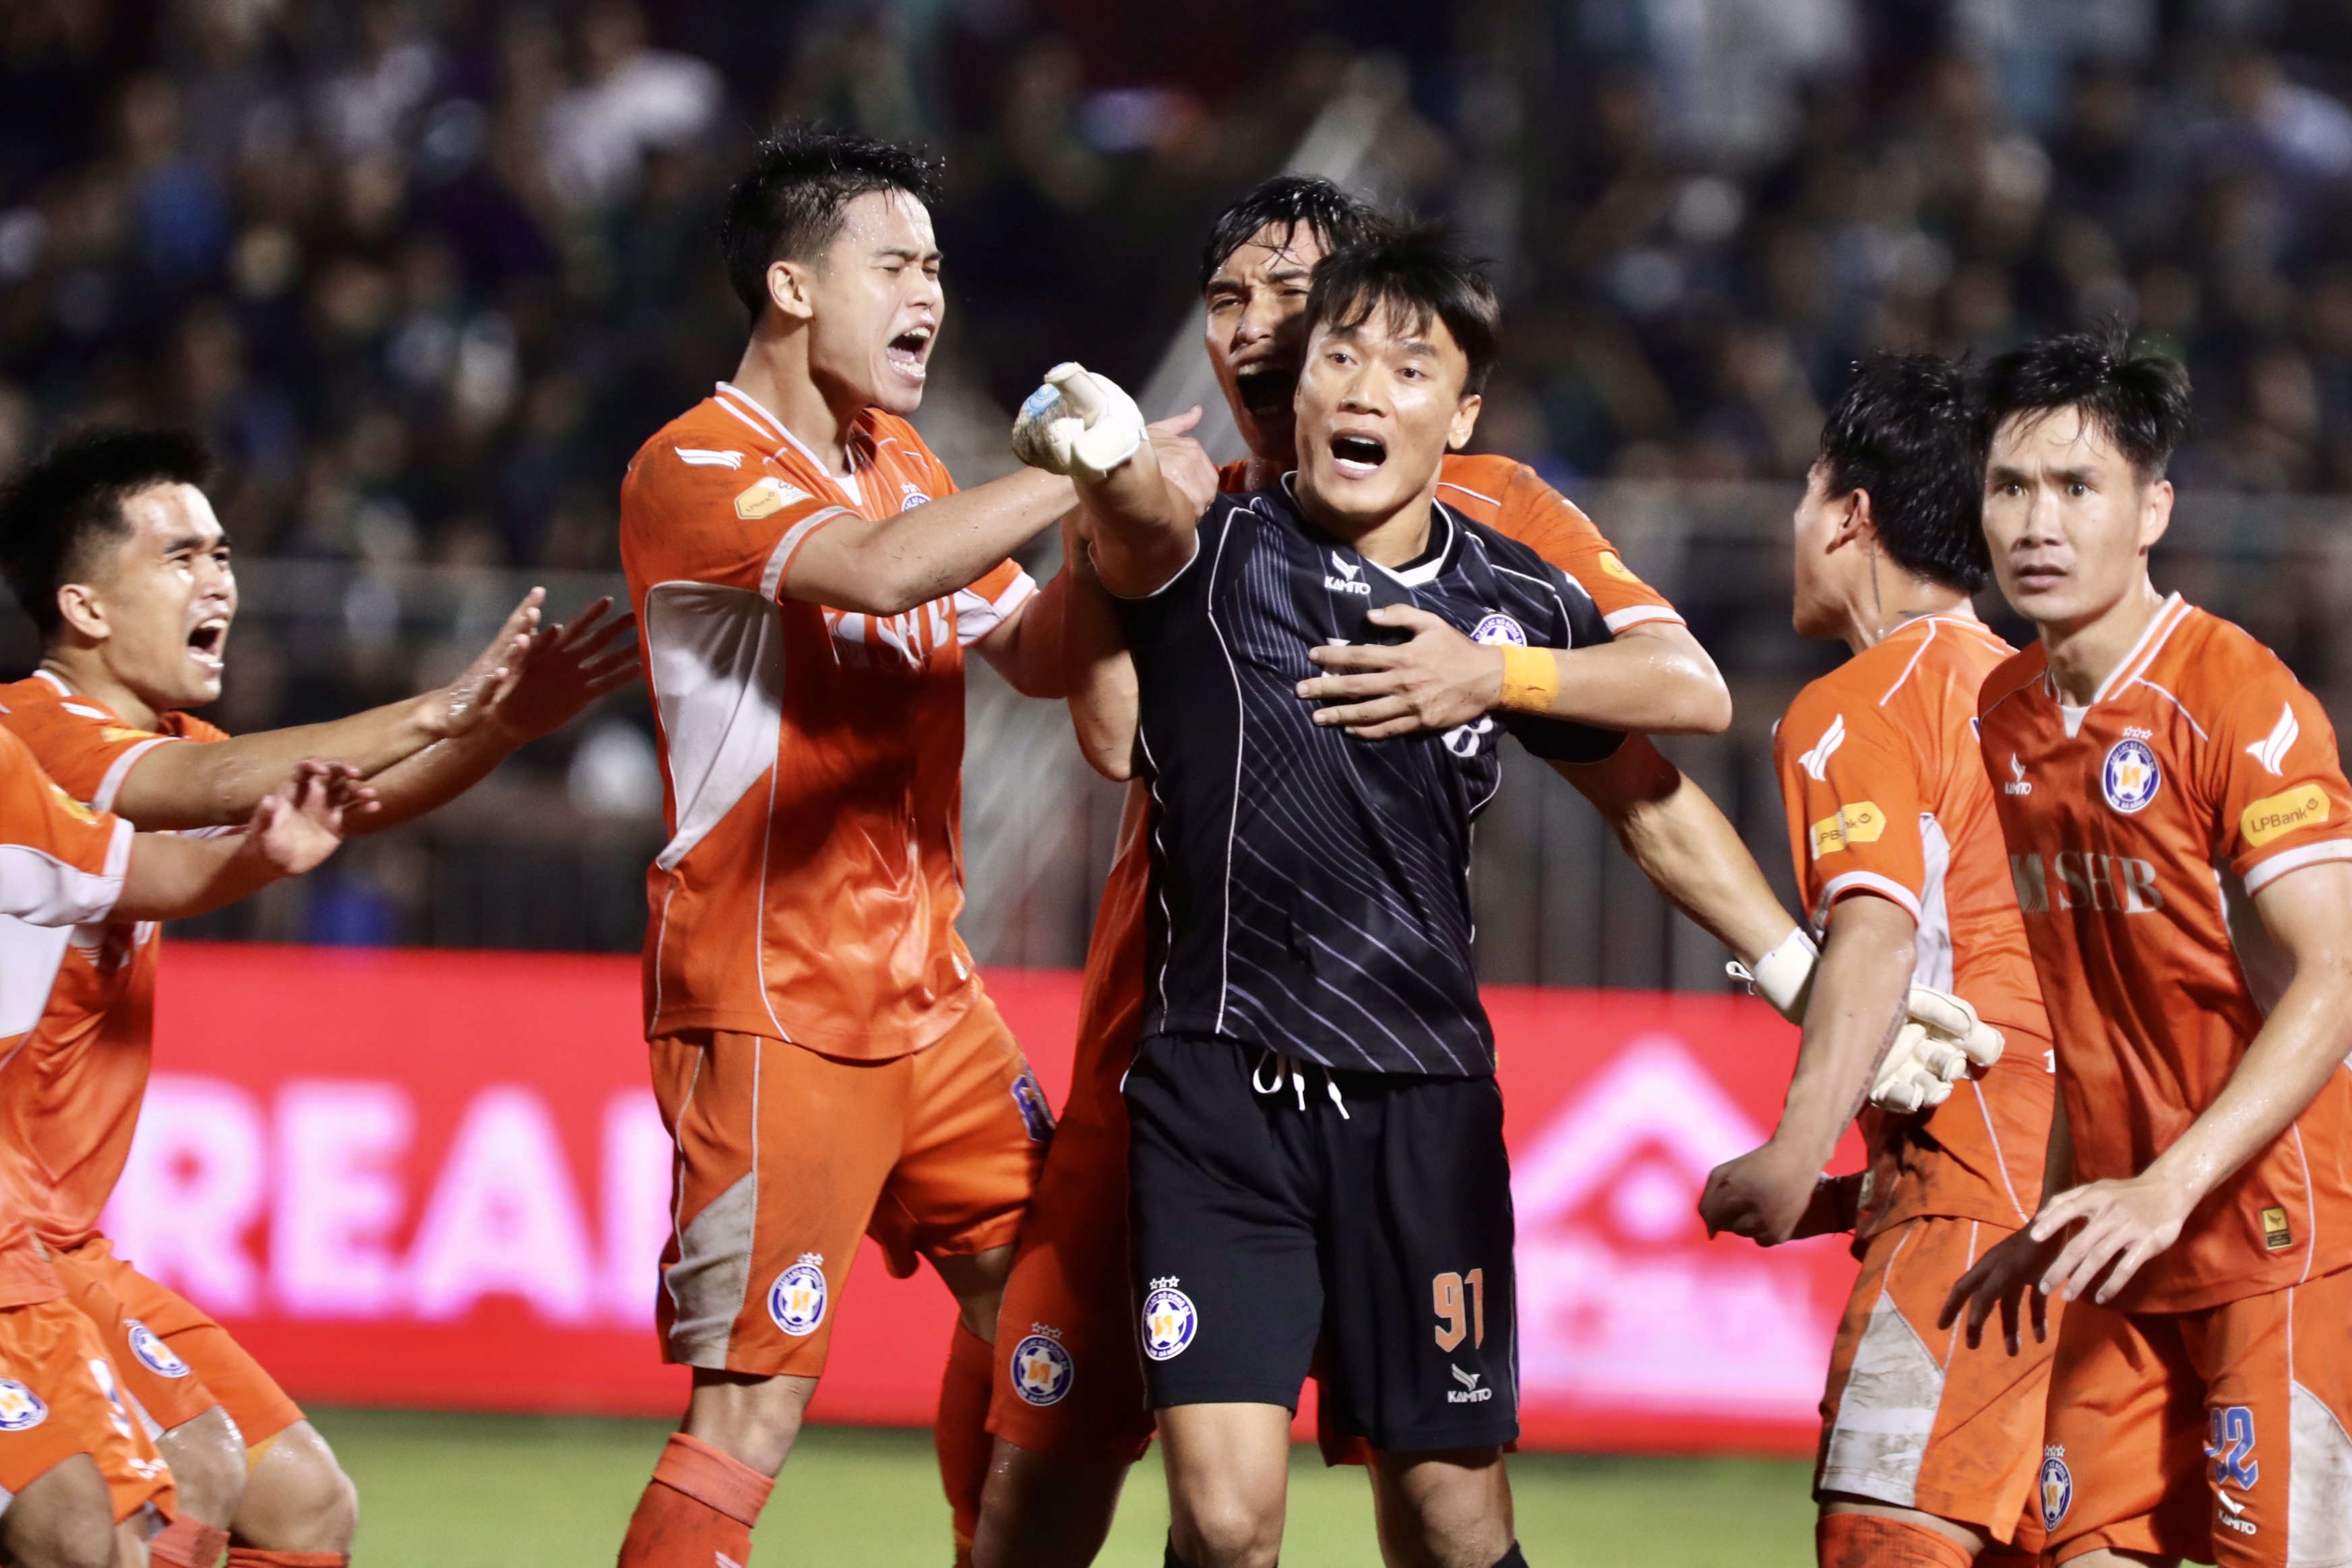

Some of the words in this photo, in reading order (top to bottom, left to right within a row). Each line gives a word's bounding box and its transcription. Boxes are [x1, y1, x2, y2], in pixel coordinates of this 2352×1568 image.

[1324, 575, 1371, 595] KAMITO
[2251, 807, 2308, 833] LPBank
[2055, 850, 2164, 914] SHB
[1433, 1267, 1484, 1352] 91
[1448, 1387, 1492, 1403] KAMITO
